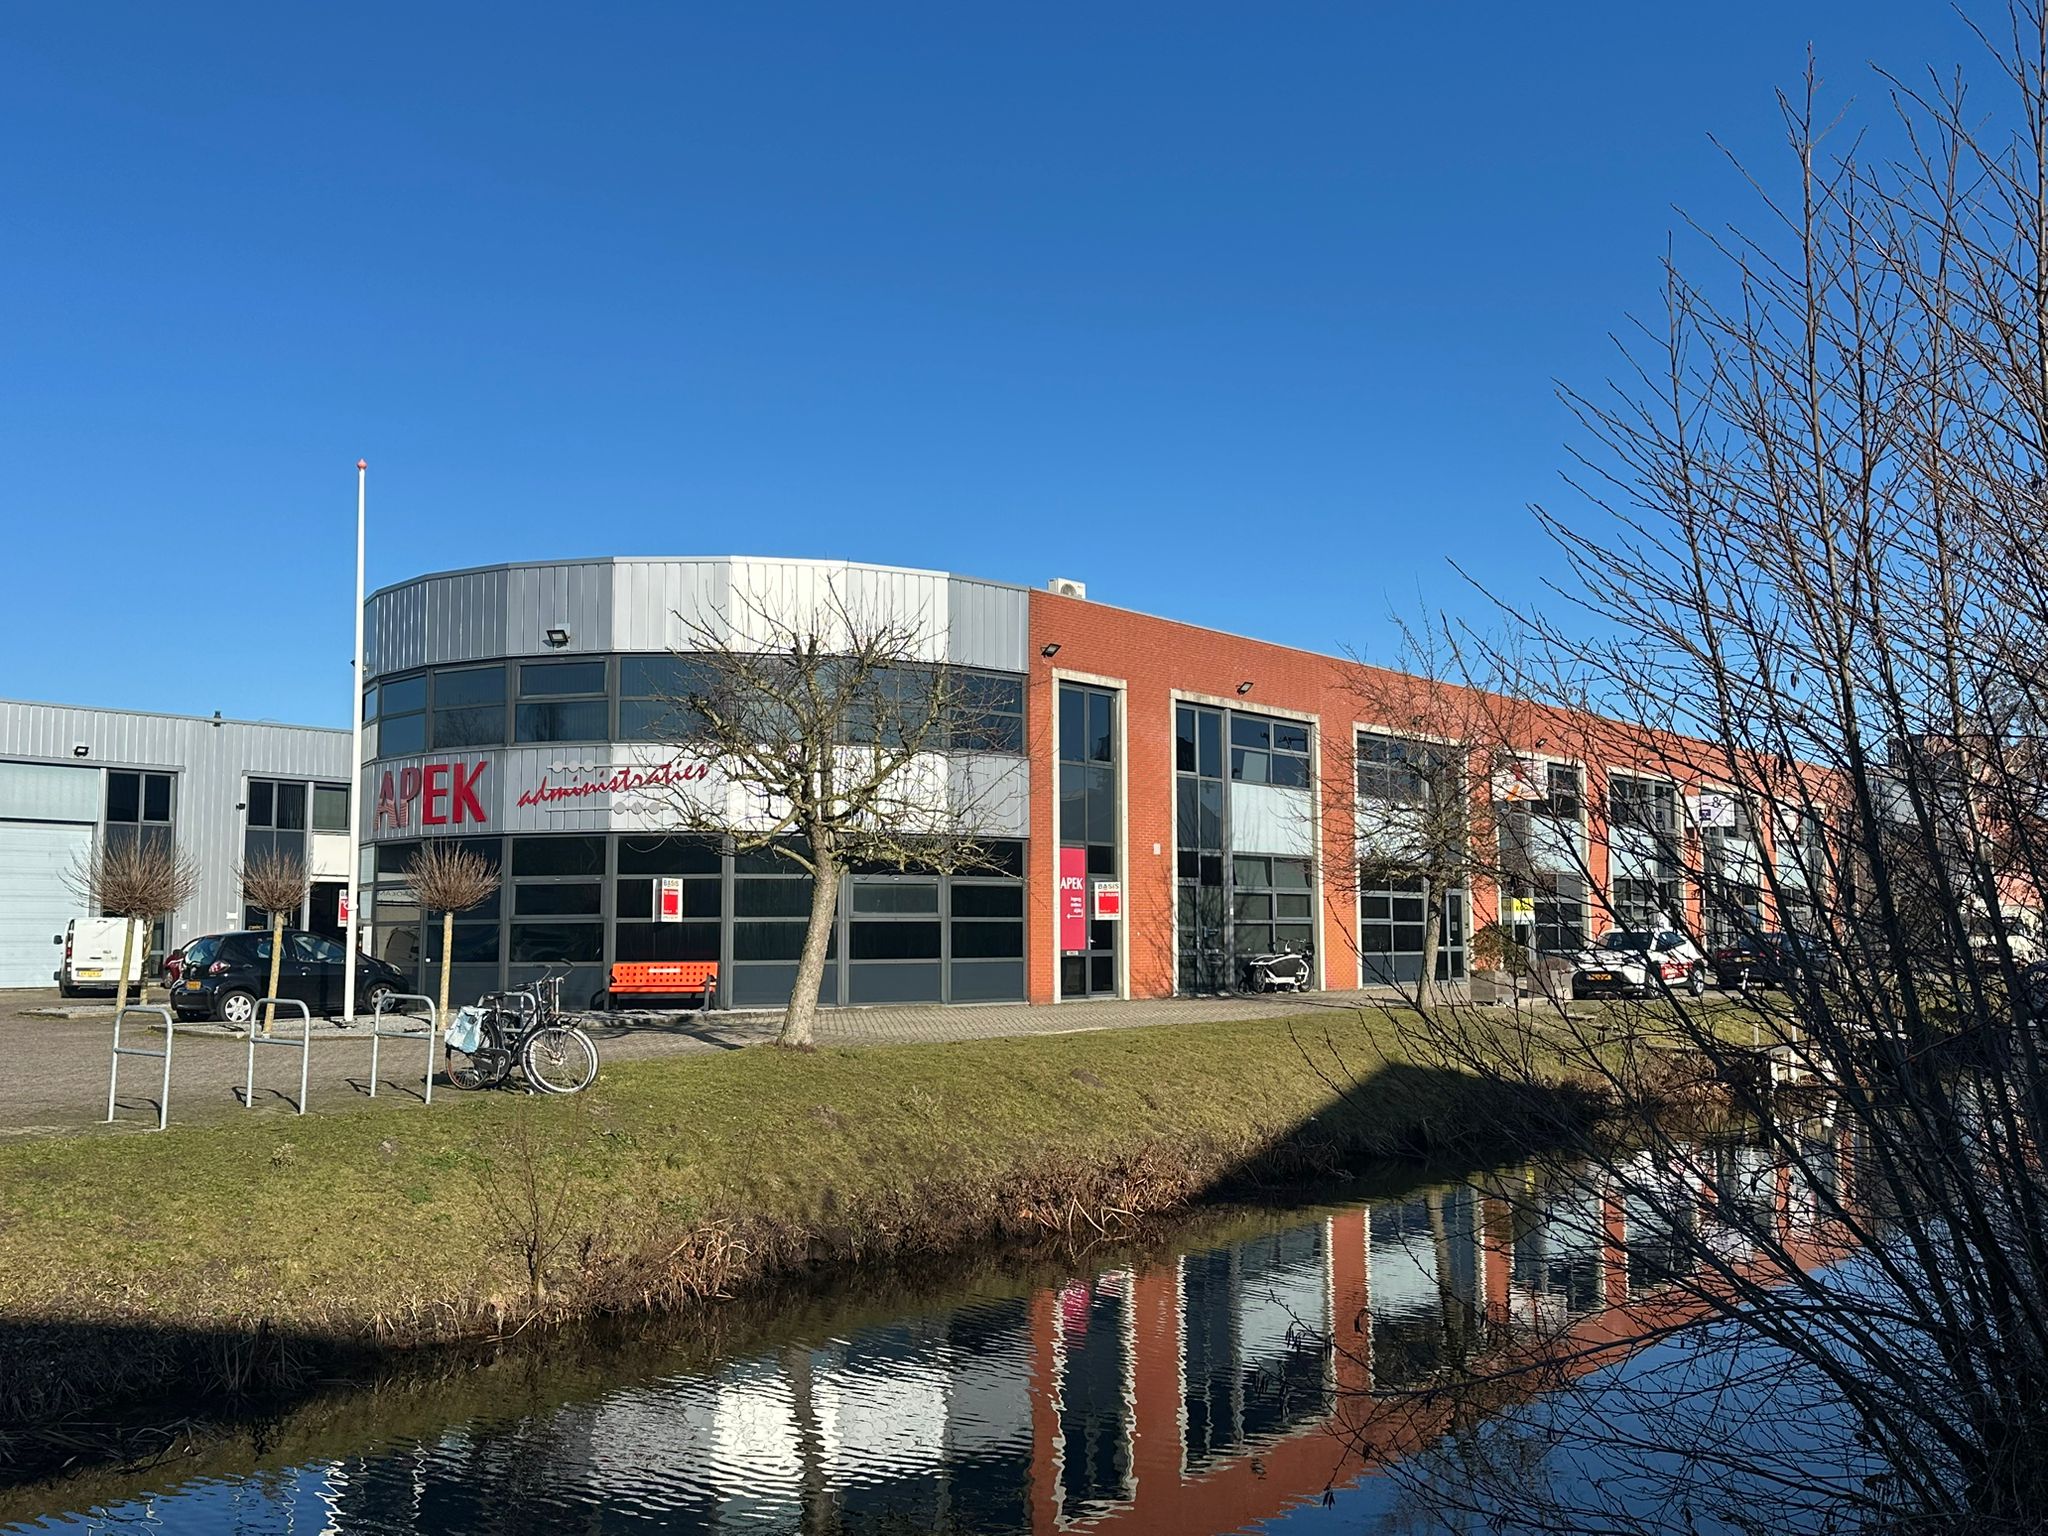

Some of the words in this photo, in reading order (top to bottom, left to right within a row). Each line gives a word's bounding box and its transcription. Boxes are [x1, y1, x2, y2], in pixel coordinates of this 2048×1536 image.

[374, 761, 488, 831] APEK
[517, 761, 709, 807] administraties
[1060, 877, 1083, 890] APEK
